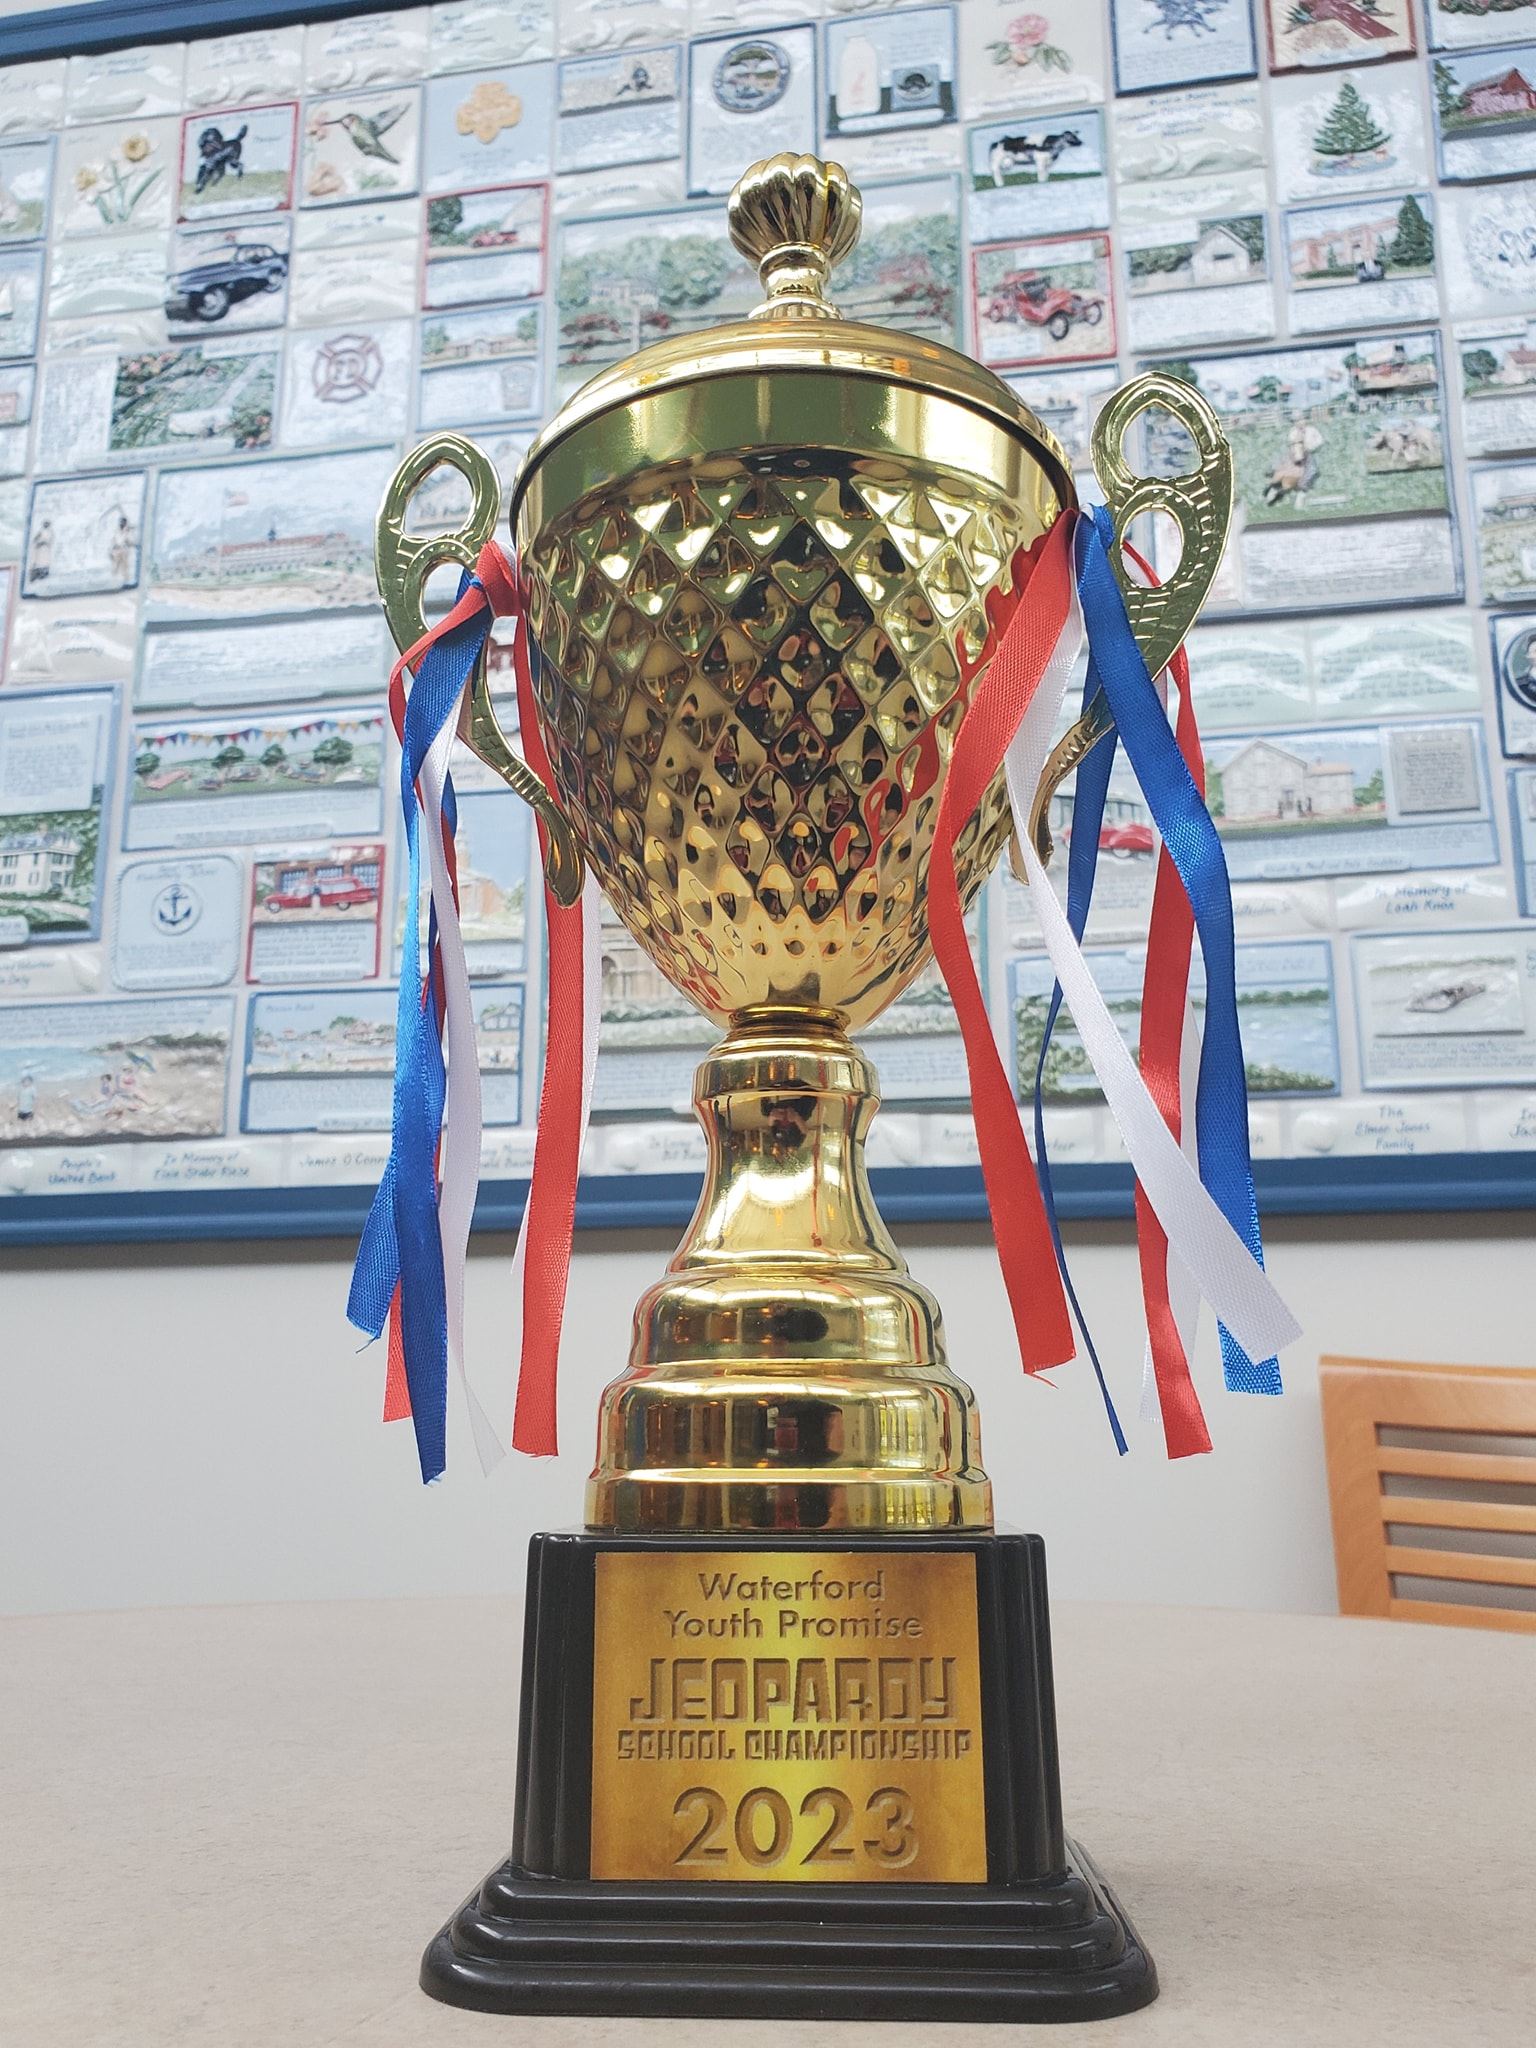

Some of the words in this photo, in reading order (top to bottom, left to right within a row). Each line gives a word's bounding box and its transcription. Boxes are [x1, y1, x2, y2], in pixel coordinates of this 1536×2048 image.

[1393, 886, 1451, 899] Memory
[1378, 1104, 1404, 1119] The
[1376, 1137, 1415, 1153] Family
[698, 1569, 885, 1602] Waterford
[663, 1609, 764, 1639] Youth
[777, 1609, 924, 1639] Promise
[628, 1656, 958, 1724] JEOPARDY
[616, 1729, 737, 1762] SCHOOL
[744, 1729, 974, 1762] CHAMPIONSHIP
[673, 1785, 920, 1870] 2023
